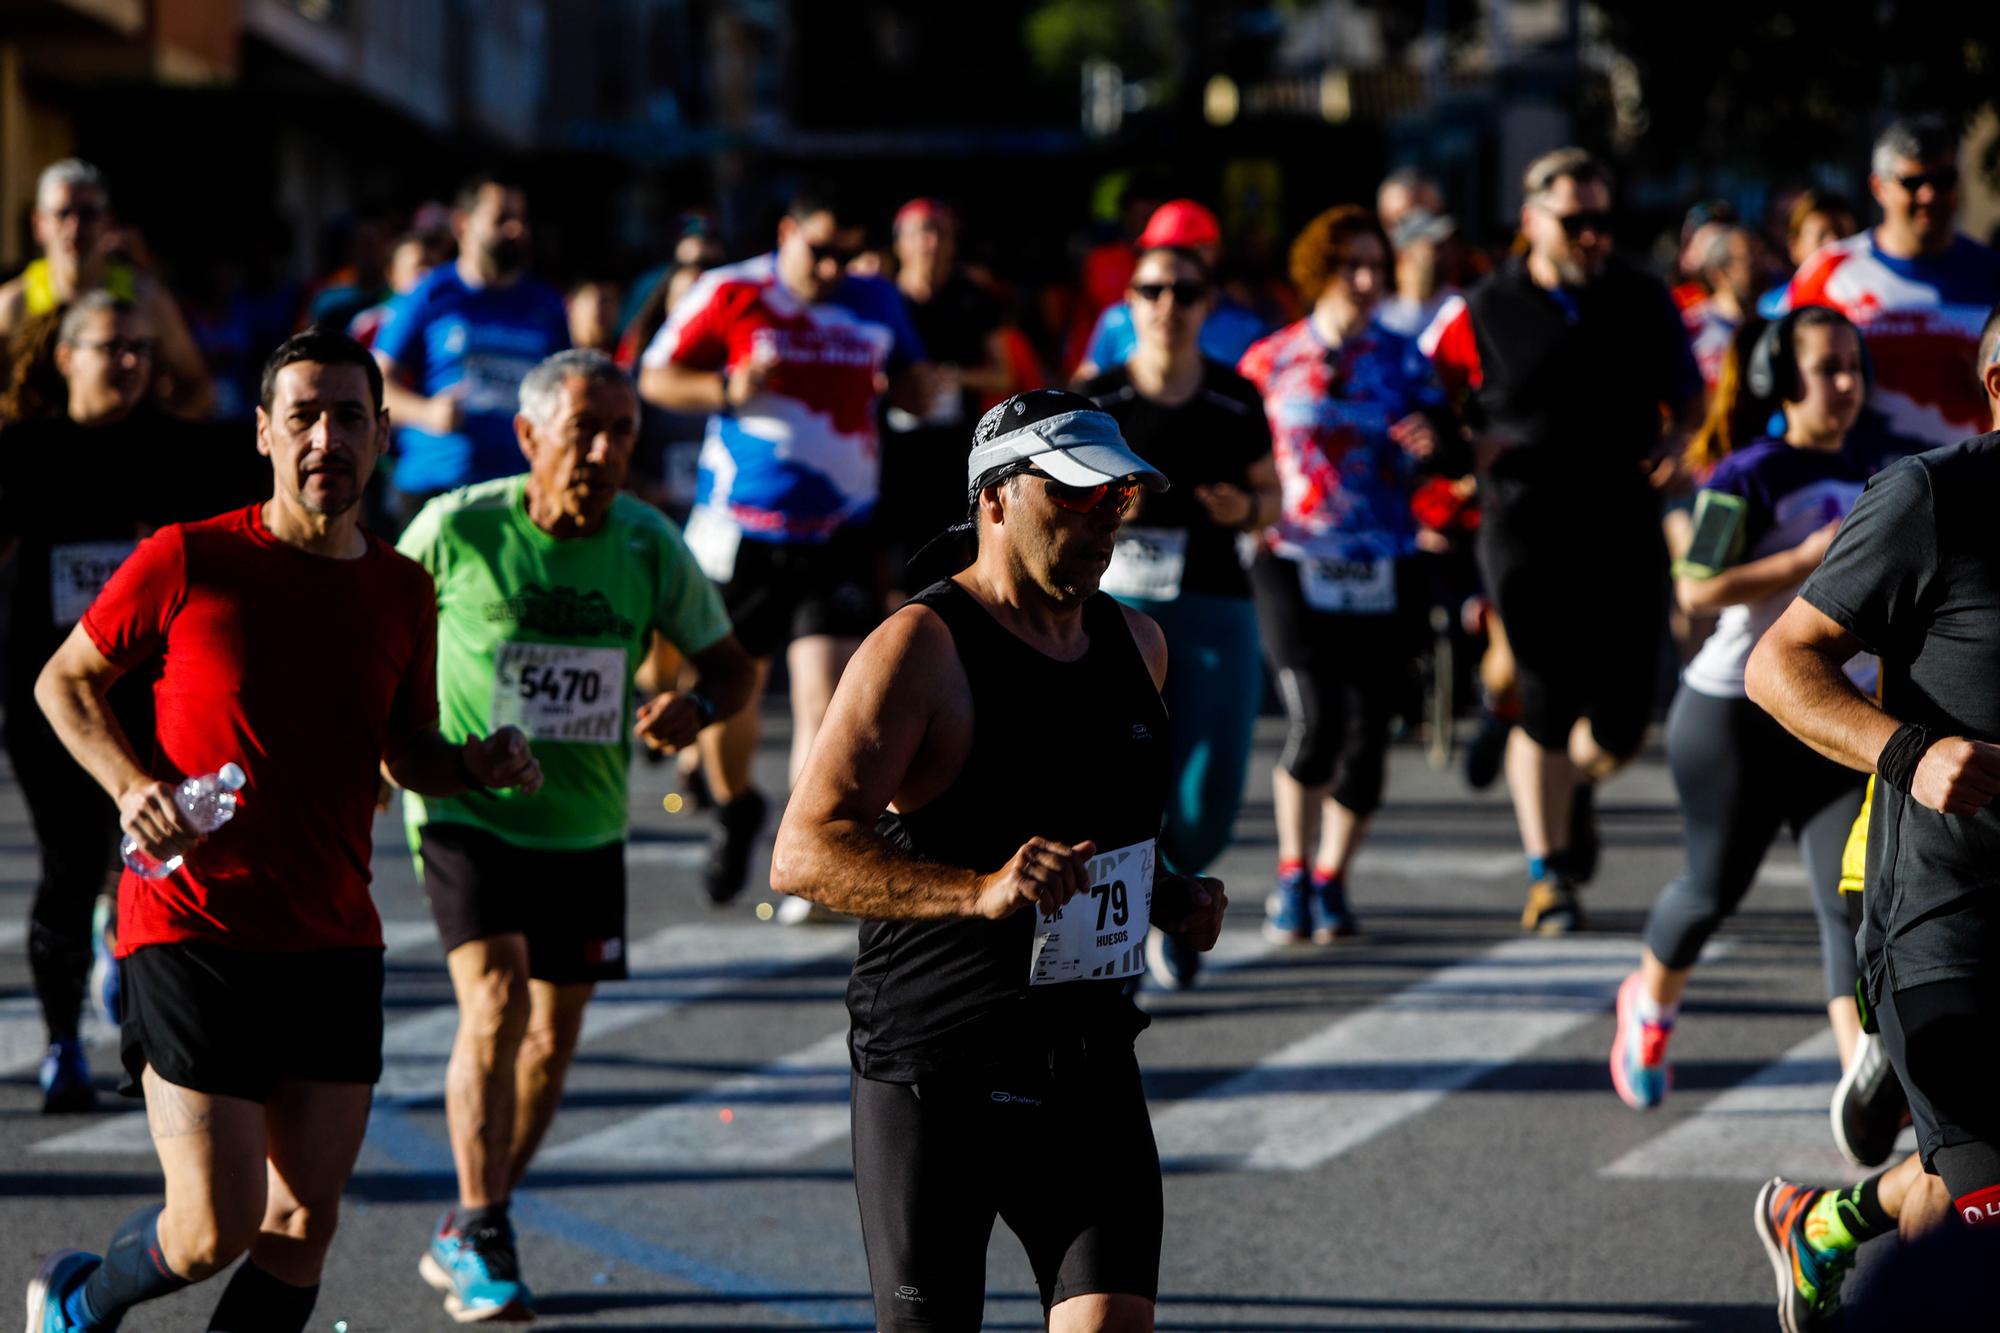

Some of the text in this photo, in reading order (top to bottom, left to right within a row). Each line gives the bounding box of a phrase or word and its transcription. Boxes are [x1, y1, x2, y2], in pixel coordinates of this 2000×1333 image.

[520, 665, 600, 704] 5470
[1091, 879, 1128, 931] 79
[1096, 930, 1129, 948] HUESOS
